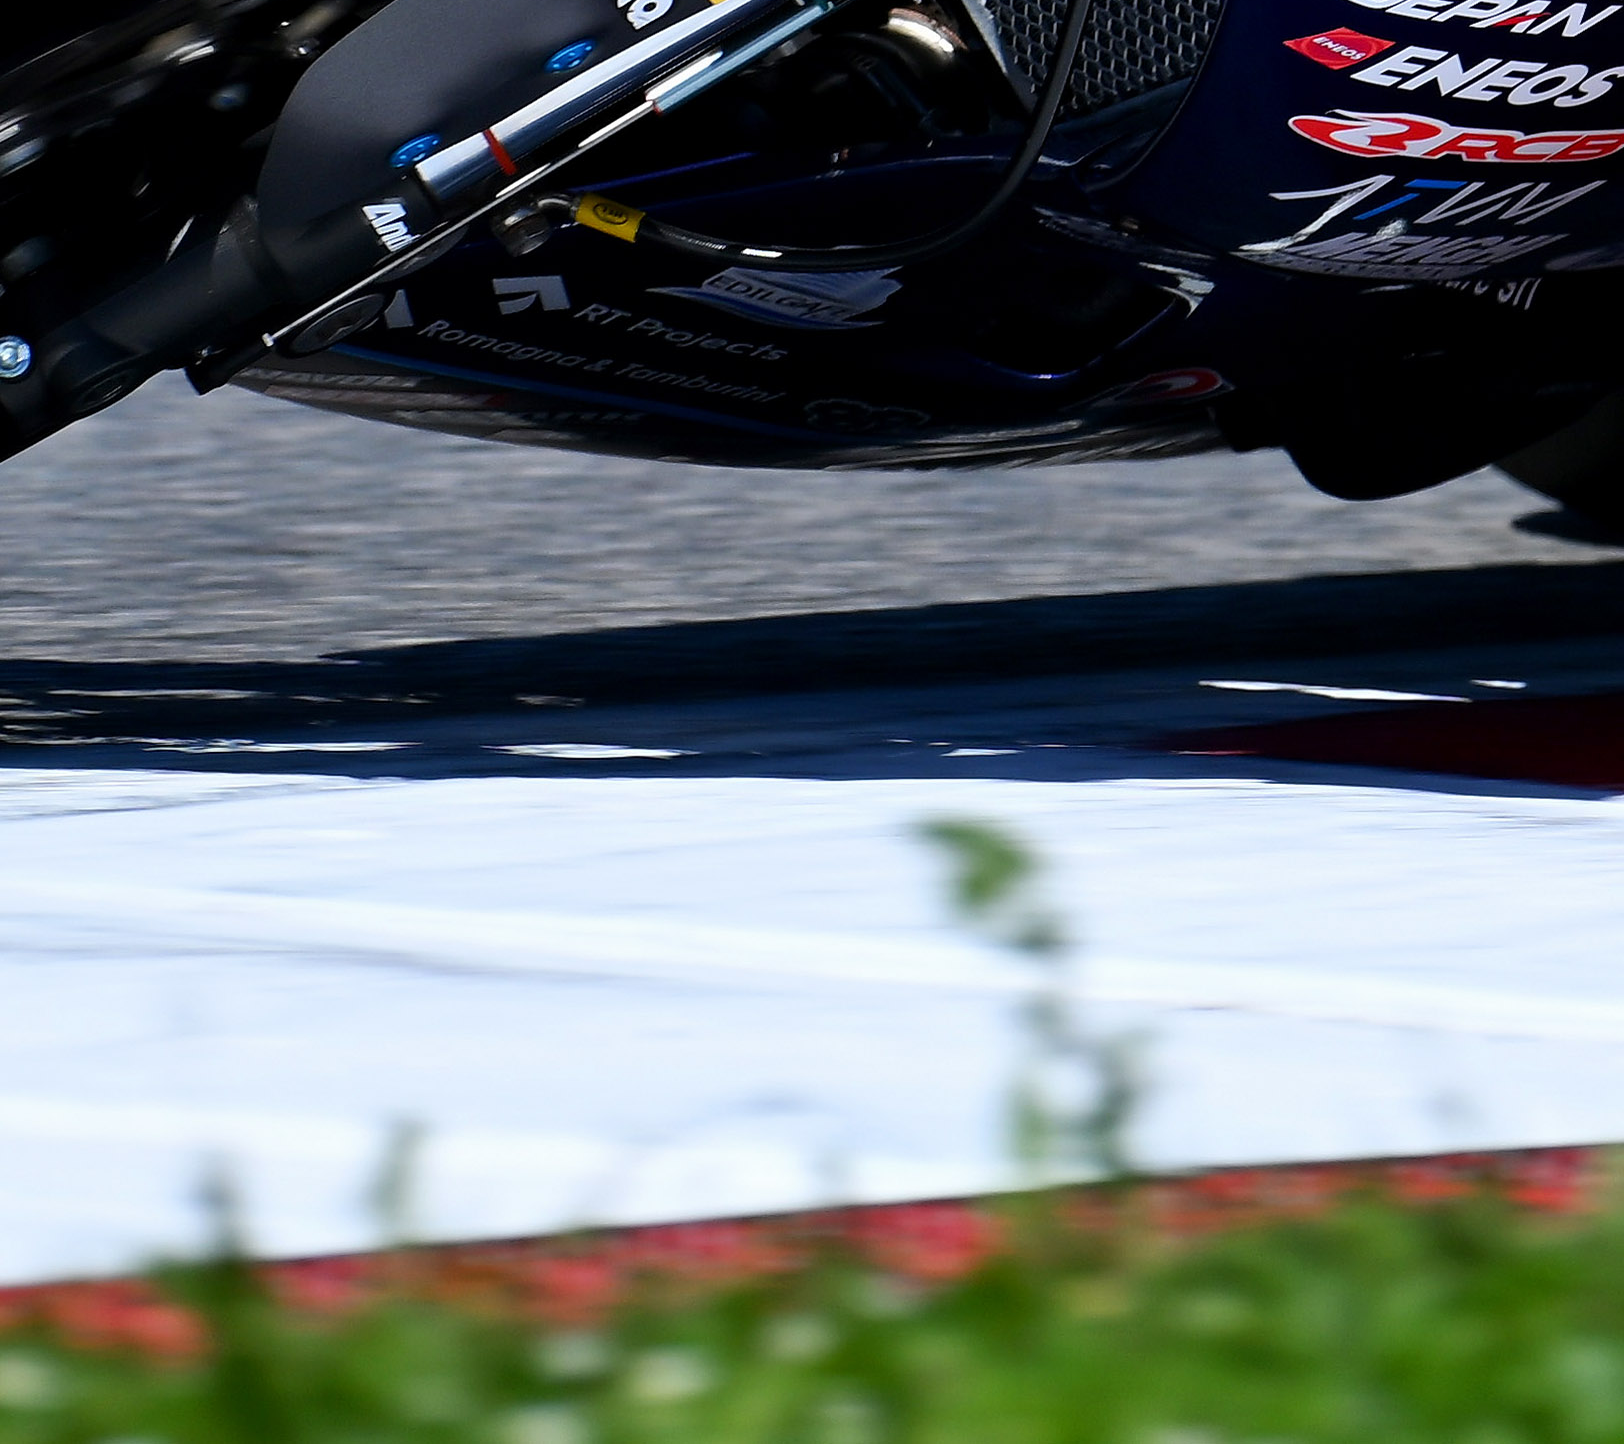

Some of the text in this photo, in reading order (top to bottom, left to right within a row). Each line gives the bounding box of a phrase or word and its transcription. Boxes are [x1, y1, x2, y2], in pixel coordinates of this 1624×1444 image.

[1311, 35, 1366, 61] ENEOS
[417, 318, 587, 370] Romagna
[574, 302, 791, 361] RT Projects
